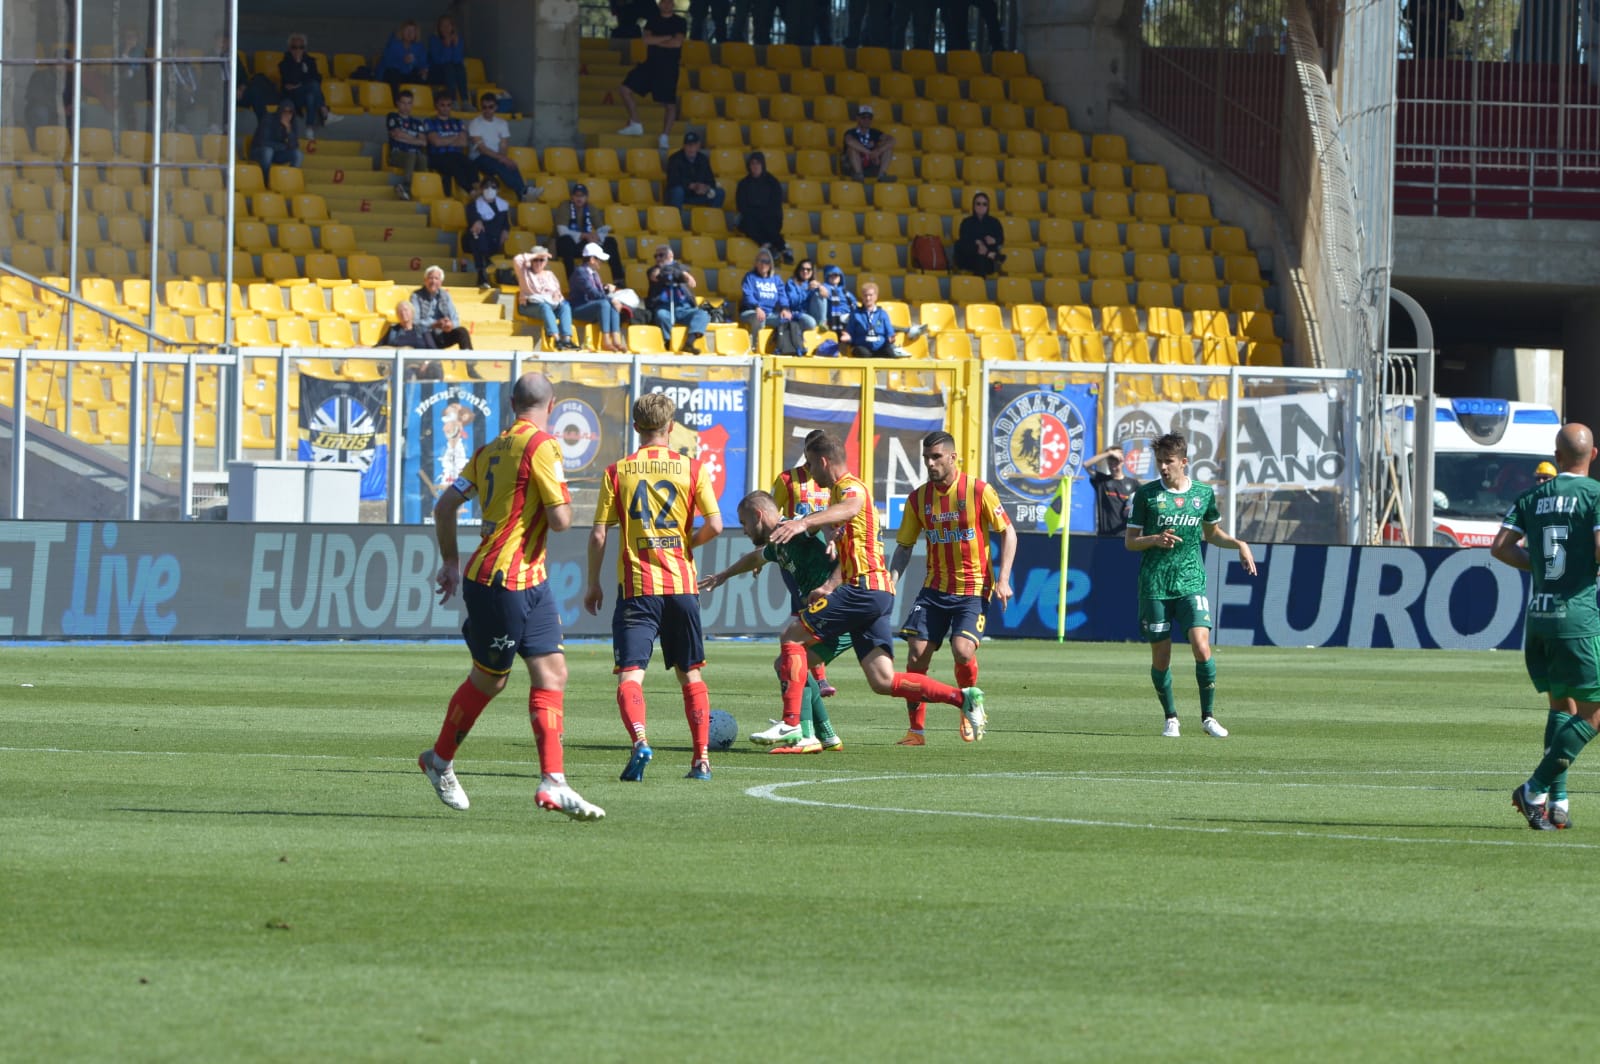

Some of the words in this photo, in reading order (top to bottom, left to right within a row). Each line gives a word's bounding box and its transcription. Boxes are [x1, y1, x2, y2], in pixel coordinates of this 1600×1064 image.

[333, 169, 344, 183] D
[360, 199, 371, 212] E
[384, 228, 394, 242] F
[684, 412, 713, 426] PISA
[1117, 419, 1158, 441] PISA
[624, 461, 682, 475] HJULMAND
[485, 455, 500, 509] 5
[629, 479, 679, 531] 42
[1016, 504, 1048, 523] PIS
[1157, 514, 1201, 527] Cetilar
[1542, 525, 1569, 581] 5
[61, 522, 182, 635] Live
[1202, 543, 1531, 650] EURO
[975, 613, 987, 633] 8
